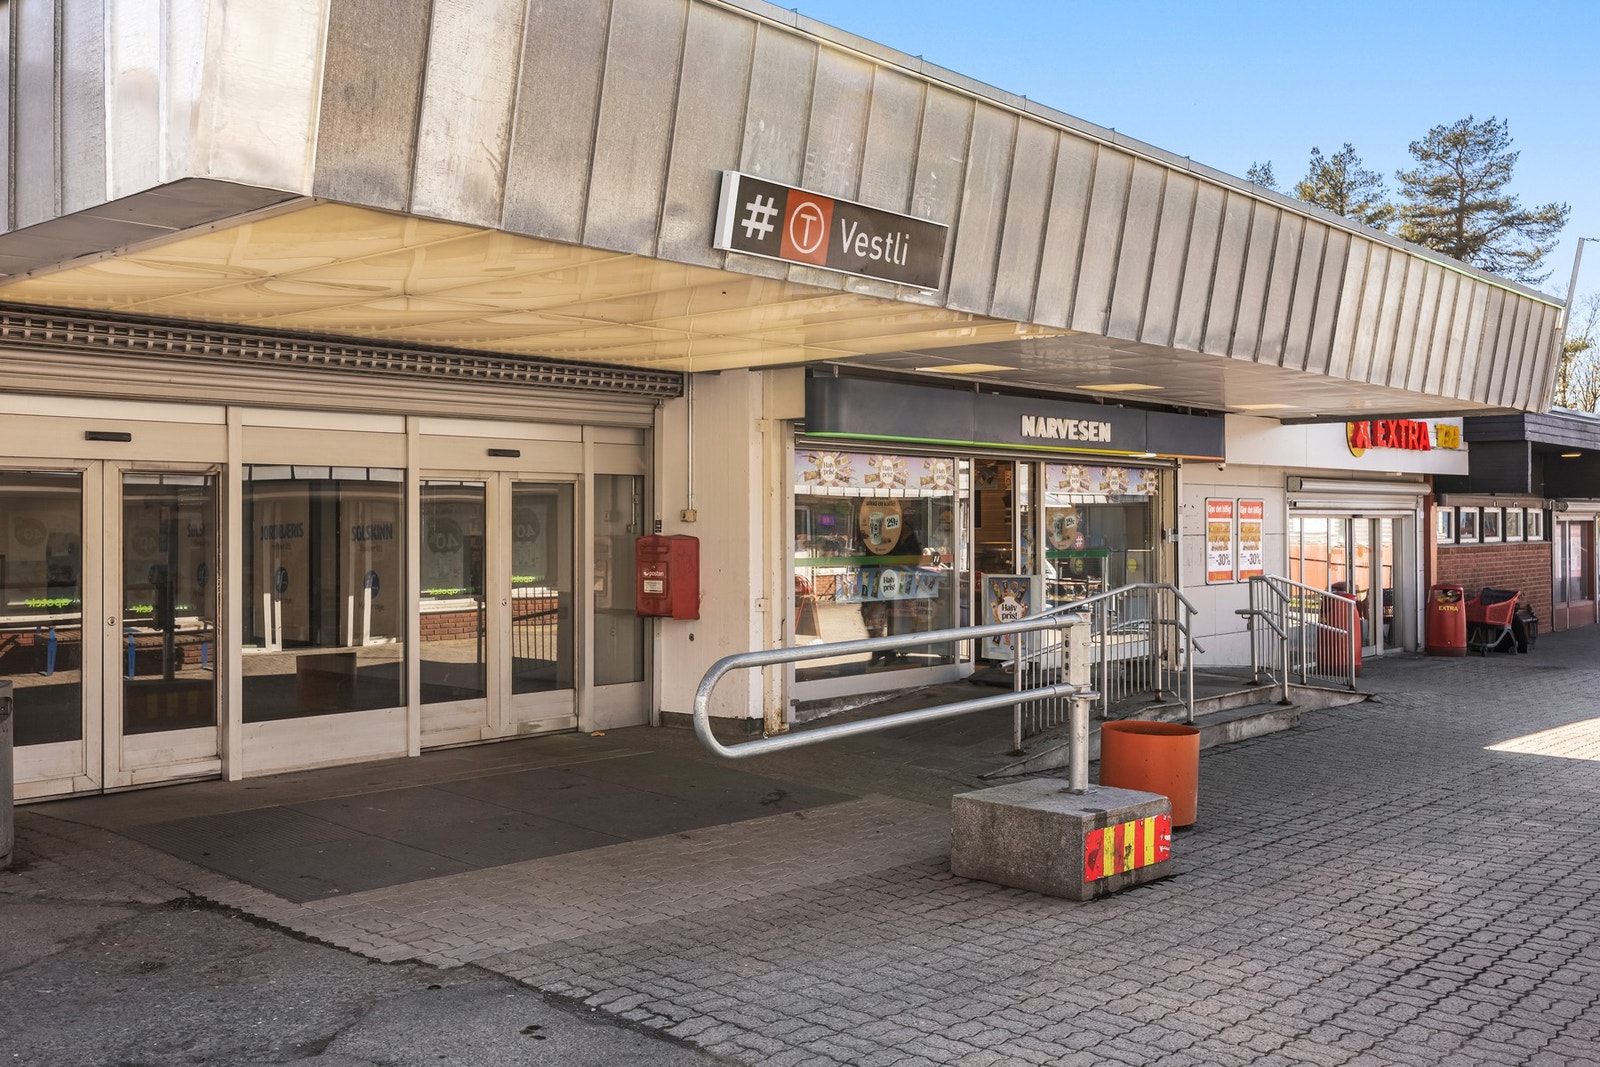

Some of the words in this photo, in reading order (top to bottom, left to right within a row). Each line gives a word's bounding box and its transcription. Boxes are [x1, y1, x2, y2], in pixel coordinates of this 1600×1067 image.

[841, 218, 910, 266] Vestli
[1021, 415, 1111, 442] NARVESEN
[1374, 419, 1431, 451] EXTRA
[351, 523, 393, 542] SOLSKINN
[1216, 553, 1231, 566] -30%
[1247, 552, 1261, 565] -30%
[1001, 603, 1018, 612] Halv
[1001, 611, 1018, 621] pris!
